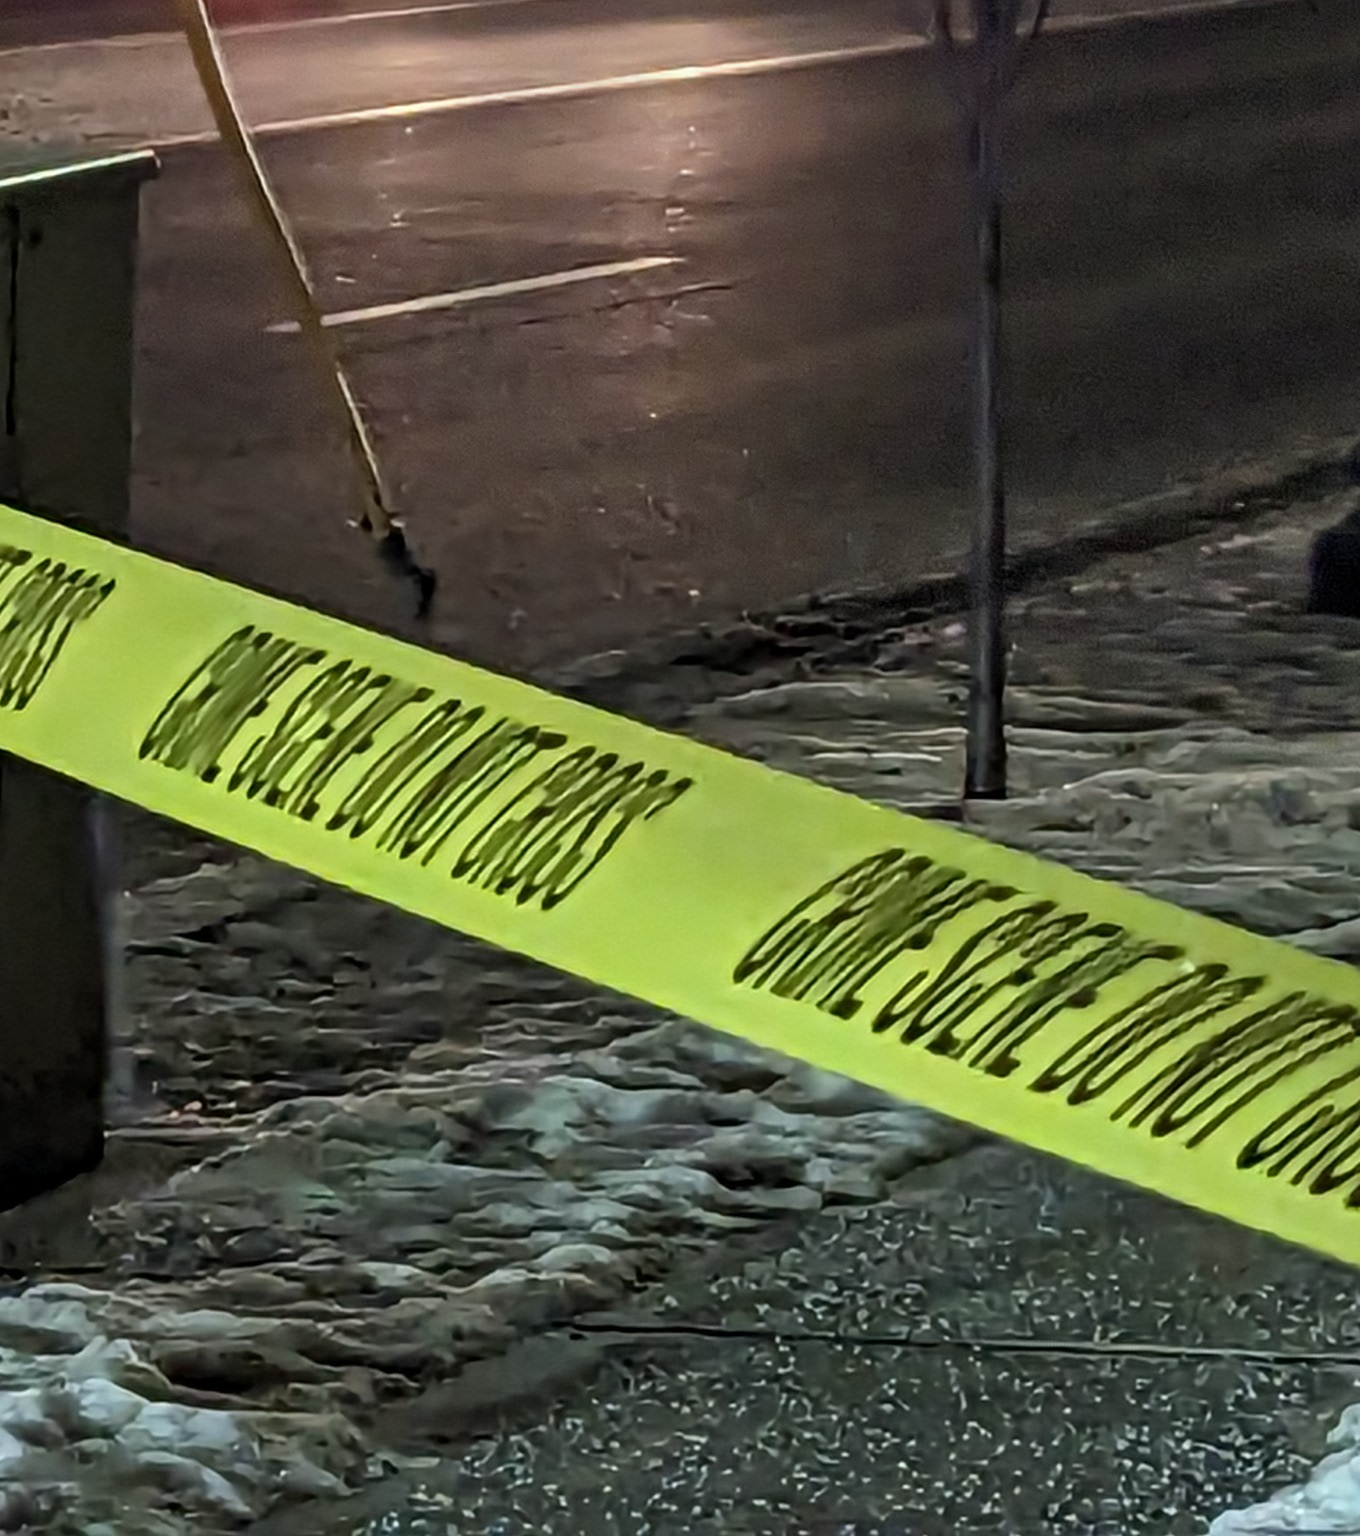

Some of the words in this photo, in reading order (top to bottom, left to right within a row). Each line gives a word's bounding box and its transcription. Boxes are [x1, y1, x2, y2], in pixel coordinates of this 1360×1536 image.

[325, 699, 486, 839] DO
[375, 717, 568, 867] NOT
[451, 745, 694, 910] CROSS
[733, 848, 1030, 1020] CRIME
[871, 901, 1186, 1077] SCENE
[1027, 963, 1269, 1105] DO
